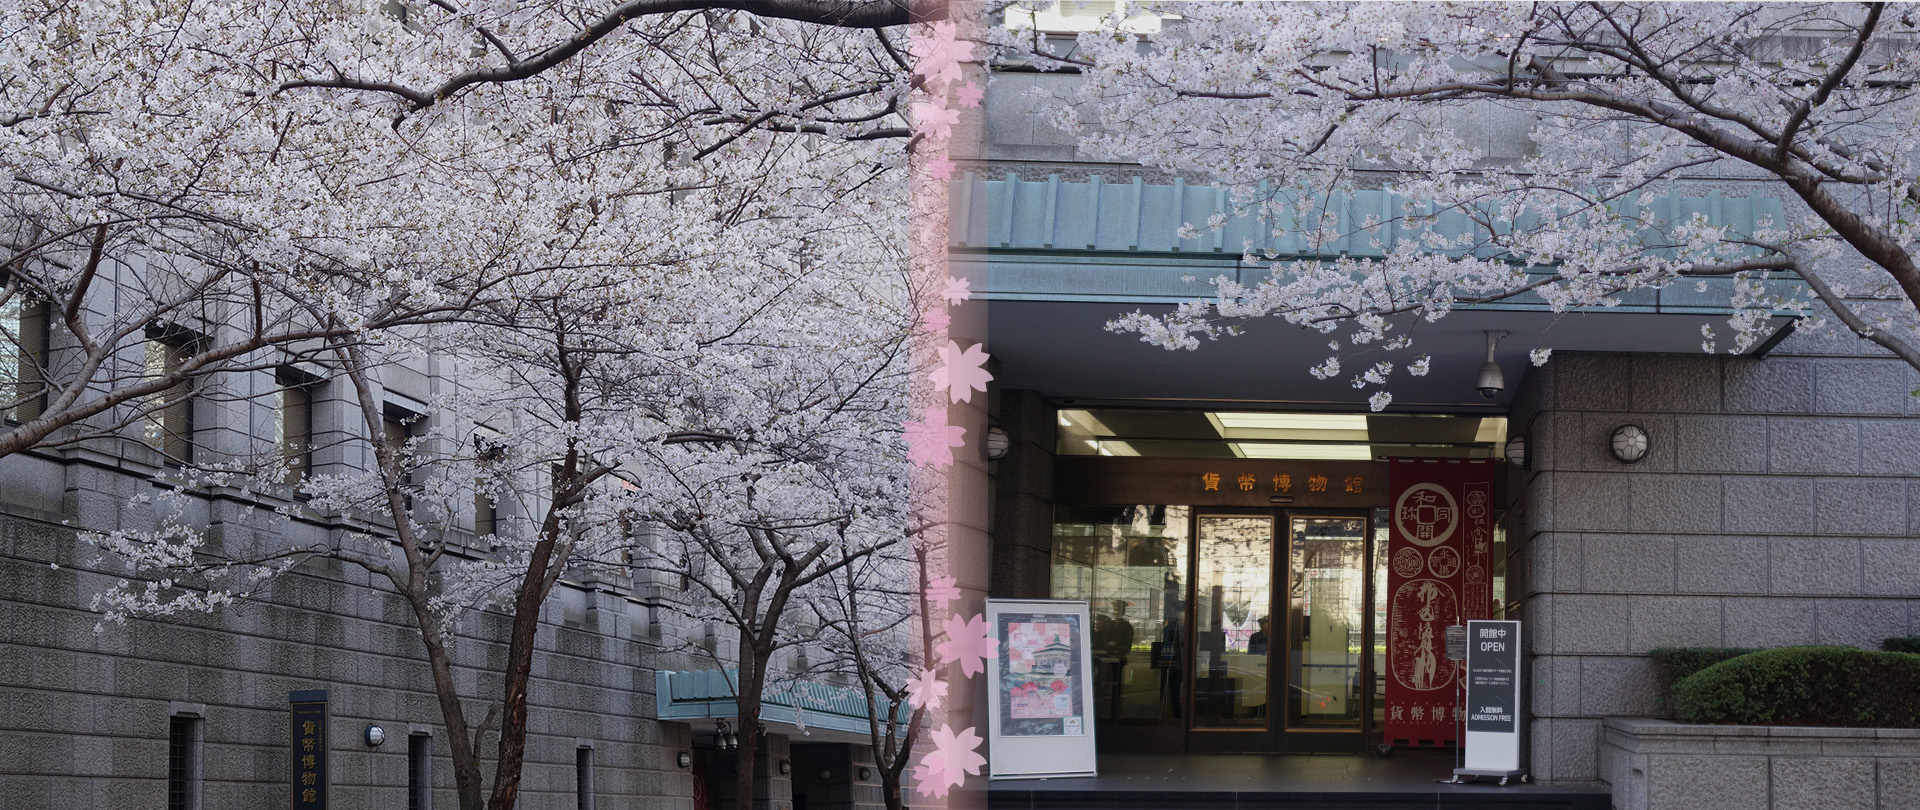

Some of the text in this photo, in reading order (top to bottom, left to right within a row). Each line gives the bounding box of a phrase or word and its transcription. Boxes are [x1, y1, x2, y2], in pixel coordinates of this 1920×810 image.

[1201, 472, 1364, 494] 貨幣博物館
[1479, 628, 1507, 639] 開館中
[1480, 641, 1505, 652] OPEN
[1498, 714, 1512, 722] FREE
[301, 720, 317, 804] 貨幣博物館
